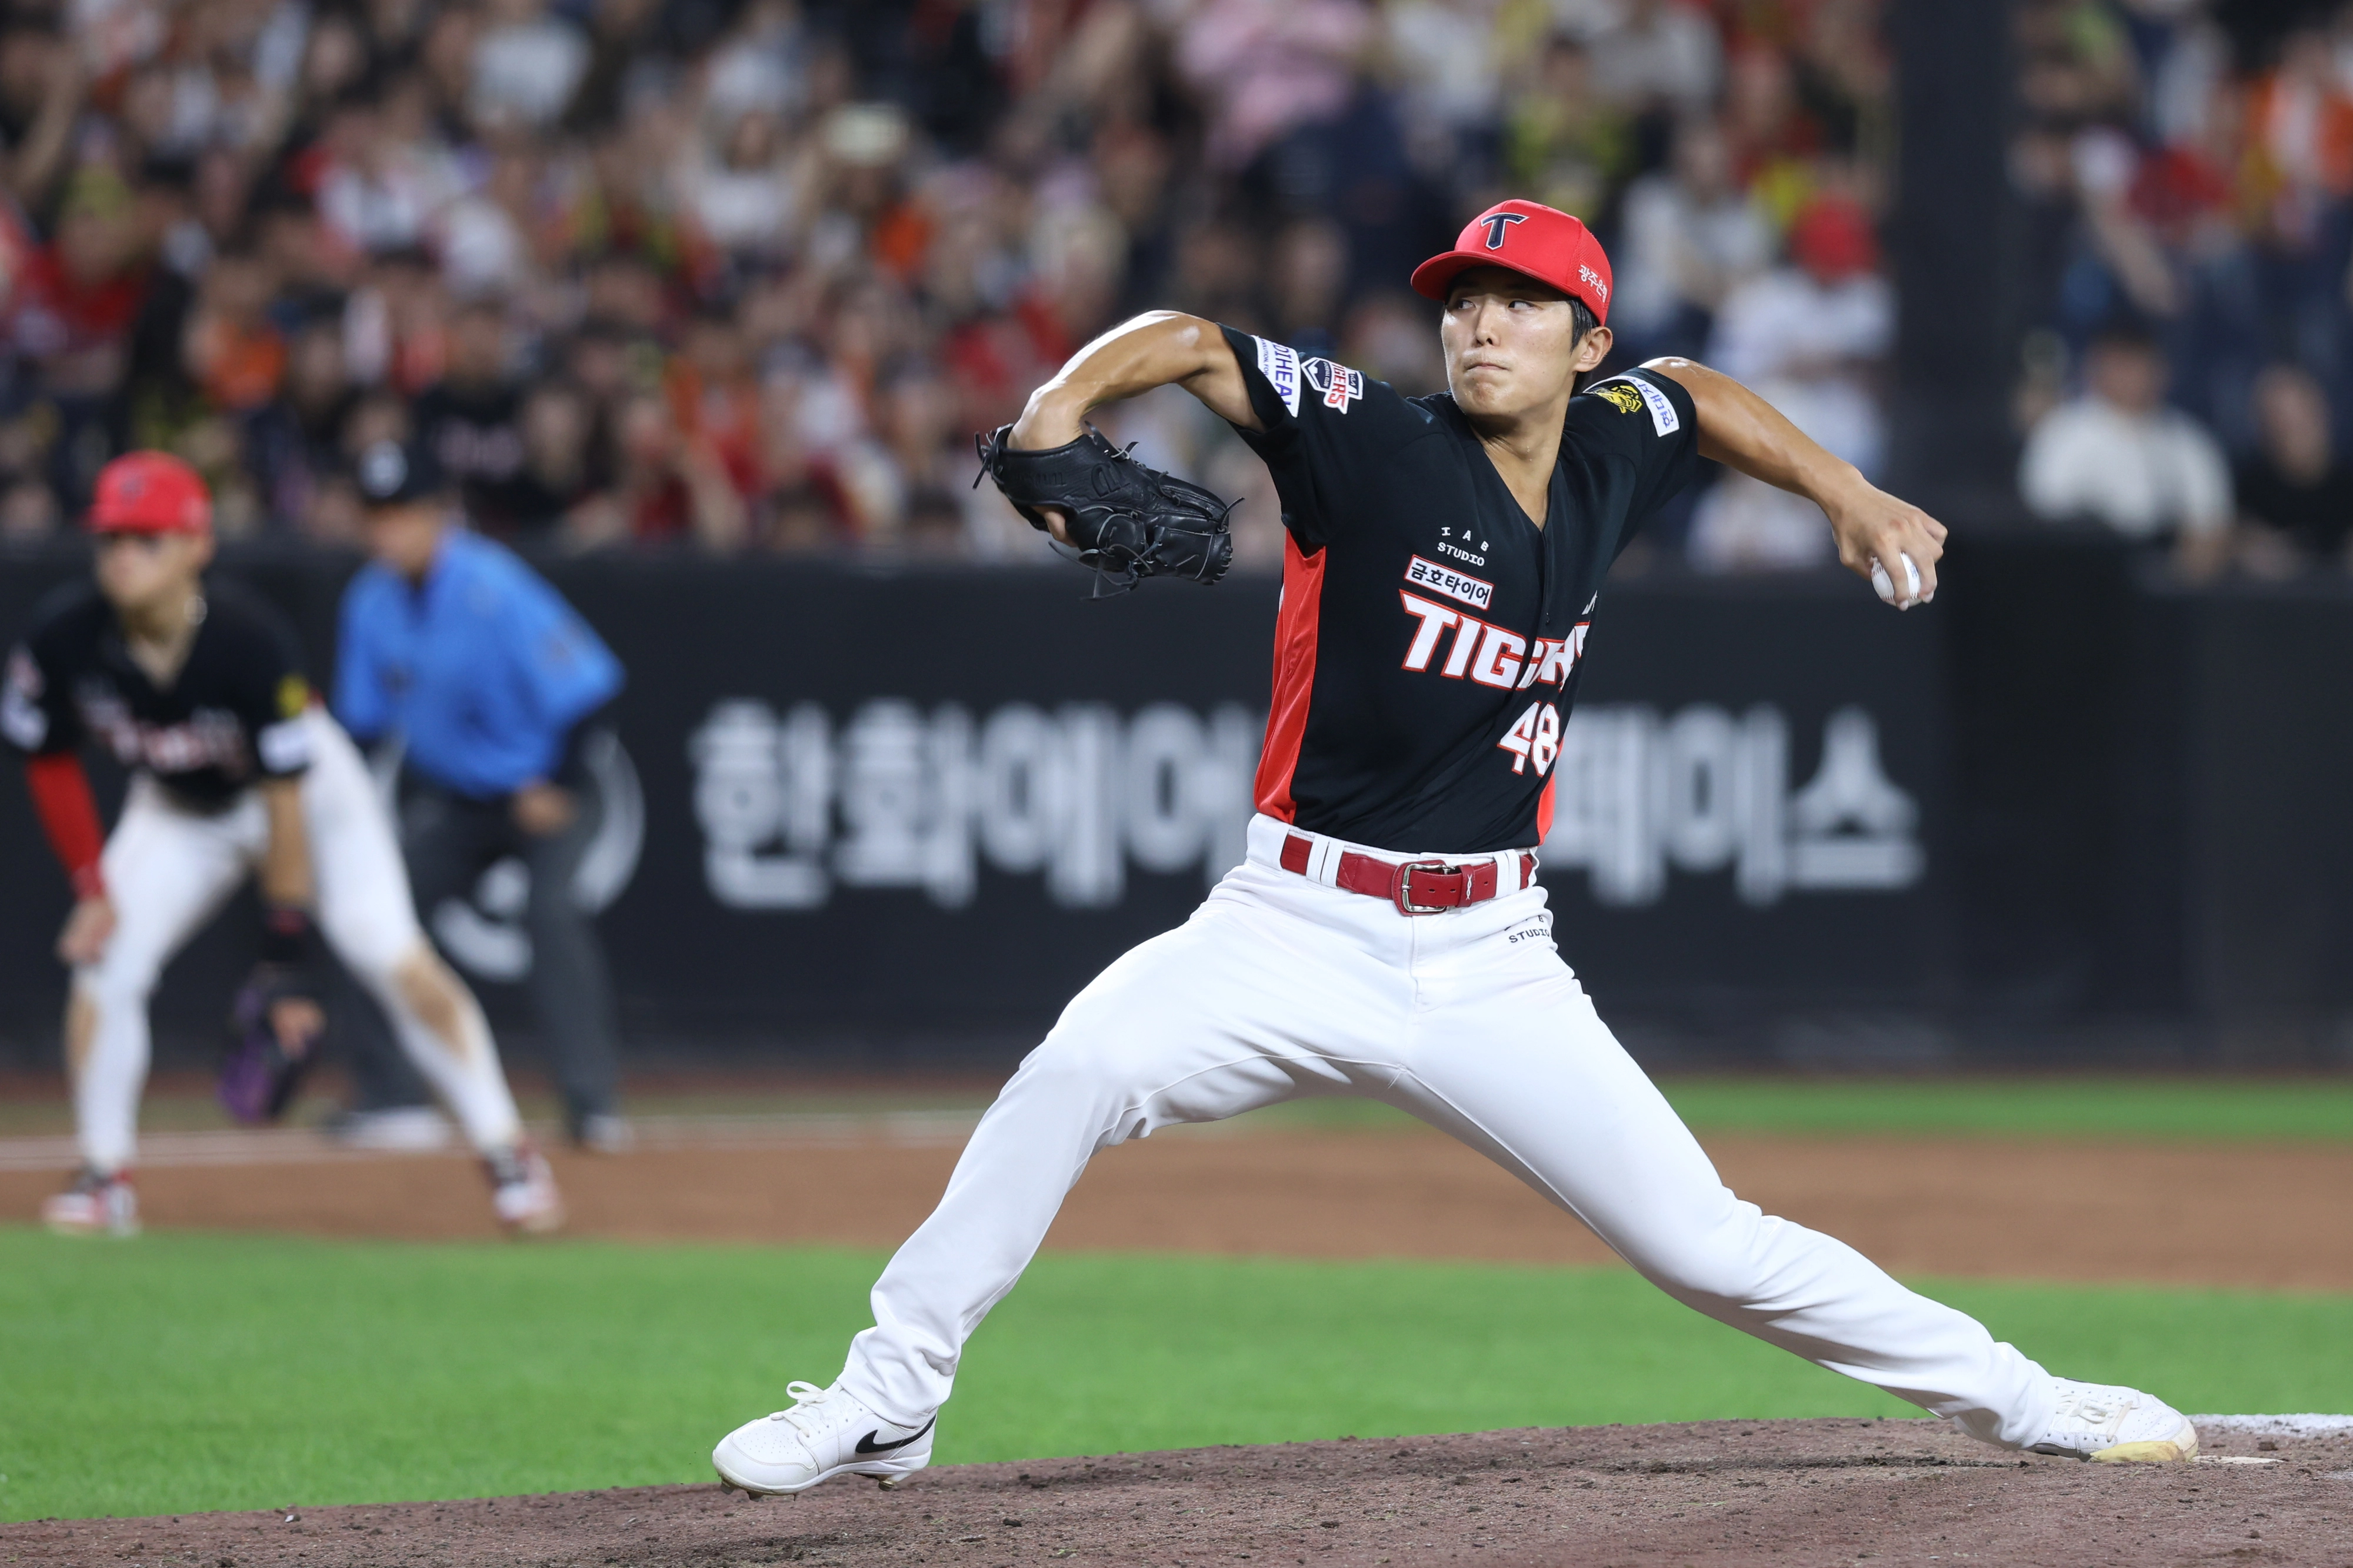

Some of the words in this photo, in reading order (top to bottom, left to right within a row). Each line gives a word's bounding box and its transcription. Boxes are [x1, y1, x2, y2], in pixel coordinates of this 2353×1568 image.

[1480, 212, 1529, 250] T
[1272, 342, 1293, 406] DIHEA
[1328, 363, 1346, 408] IGERS
[1625, 378, 1674, 428] 현대차
[1437, 542, 1485, 567] STUDIO
[1411, 561, 1490, 606] 금호타이어
[1496, 699, 1560, 778] 48
[1508, 928, 1550, 943] STUDIO
